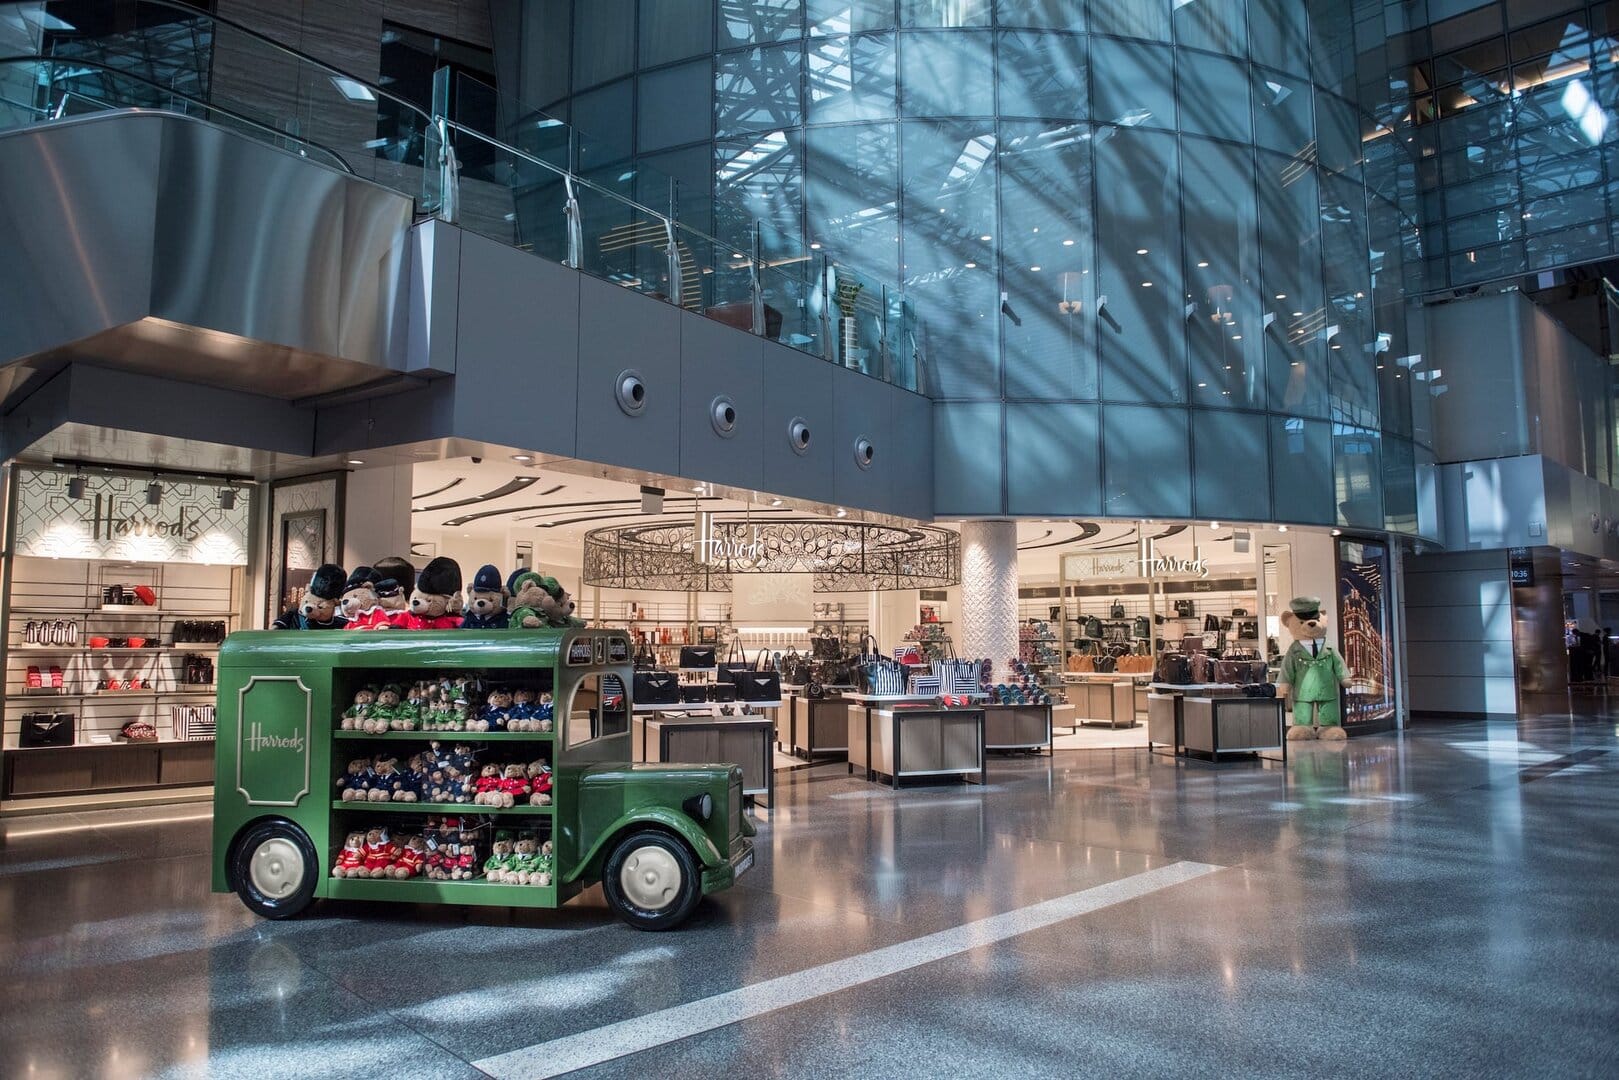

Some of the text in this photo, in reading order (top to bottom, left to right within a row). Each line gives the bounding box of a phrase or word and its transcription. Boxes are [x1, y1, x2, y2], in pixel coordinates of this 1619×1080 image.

[80, 493, 199, 541] Harrods
[693, 512, 764, 568] Harrods
[1131, 537, 1208, 578] Harrods
[1091, 557, 1124, 575] Harrods
[244, 721, 304, 753] Harrods
